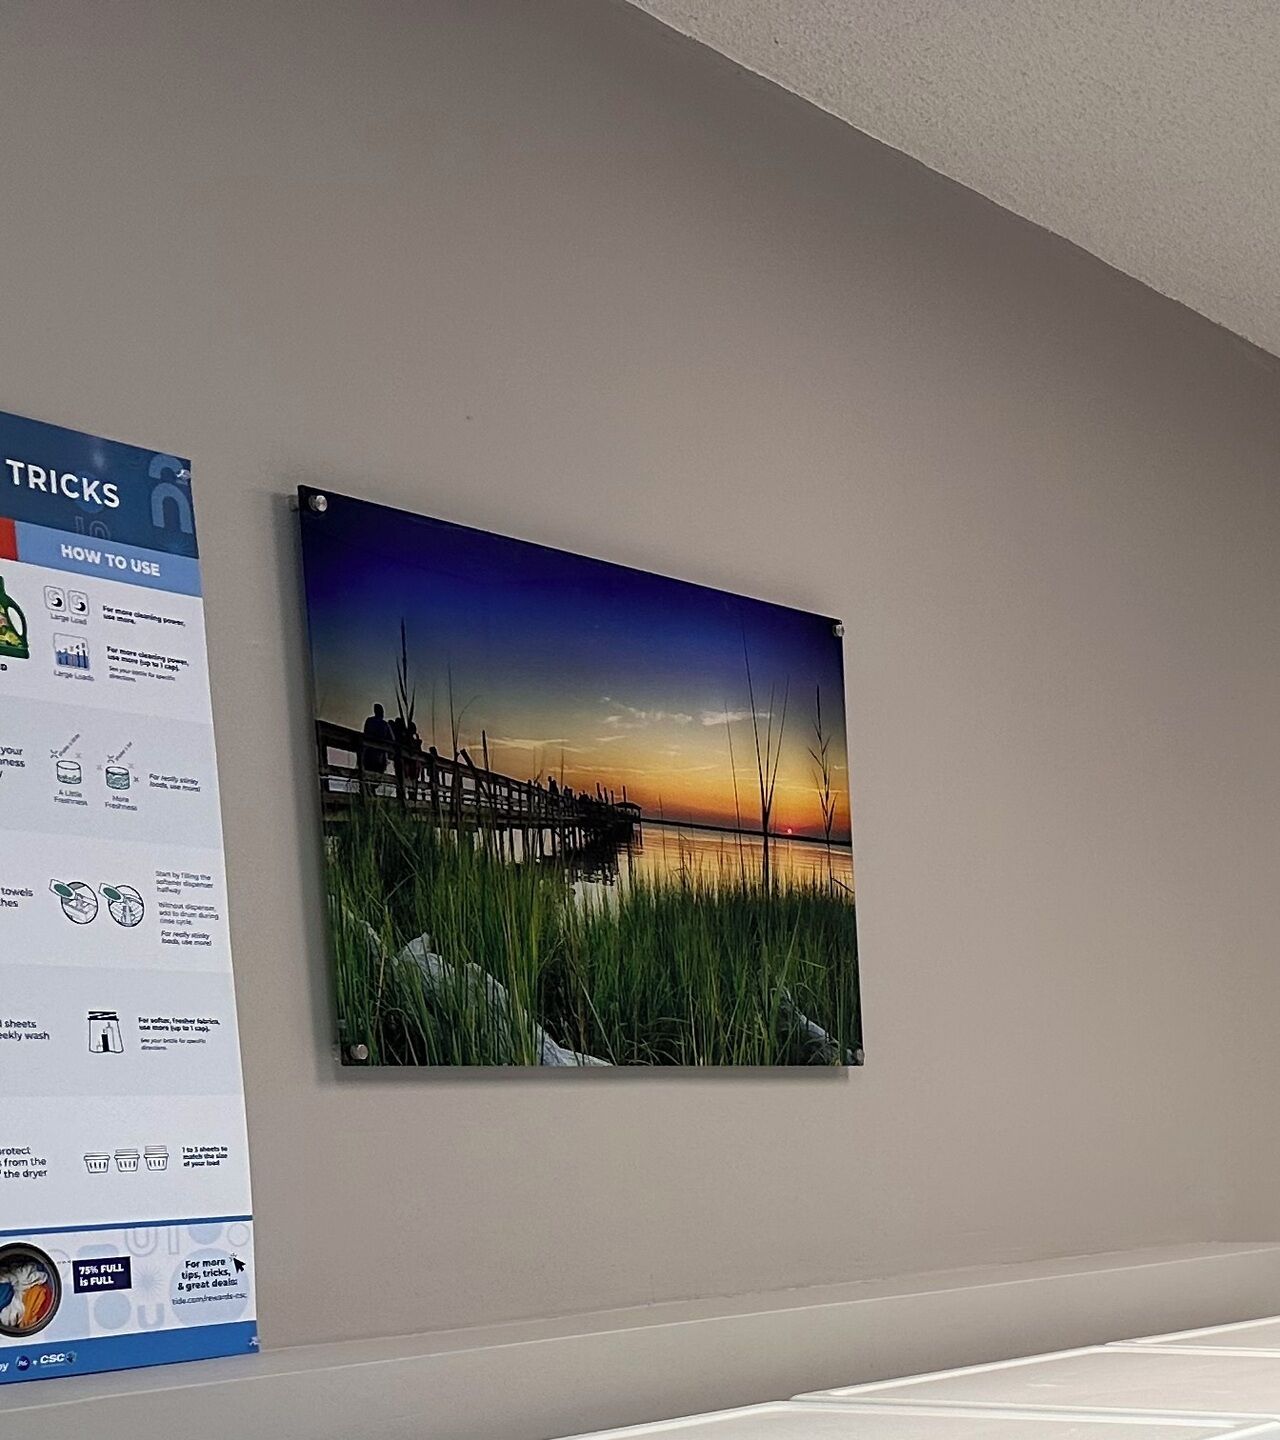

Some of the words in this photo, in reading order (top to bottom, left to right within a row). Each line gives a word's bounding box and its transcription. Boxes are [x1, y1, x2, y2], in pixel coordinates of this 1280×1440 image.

[5, 459, 120, 508] TRICKS
[61, 544, 101, 564] HOW
[105, 553, 126, 570] TO
[130, 558, 161, 577] USE
[0, 746, 23, 755] your
[1, 887, 34, 897] towels
[5, 1019, 37, 1028] sheets
[25, 1031, 50, 1040] wash
[4, 1158, 28, 1167] from
[30, 1157, 47, 1166] the
[4, 1169, 20, 1178] the
[22, 1169, 47, 1180] dryer
[186, 1260, 200, 1268] For
[203, 1259, 226, 1267] more
[79, 1265, 98, 1275] 75%
[101, 1264, 124, 1273] FULL
[182, 1271, 201, 1280] tips,
[203, 1269, 231, 1277] tricks,
[90, 1276, 114, 1286] FULL
[186, 1281, 210, 1292] great
[41, 1353, 65, 1364] CSC
